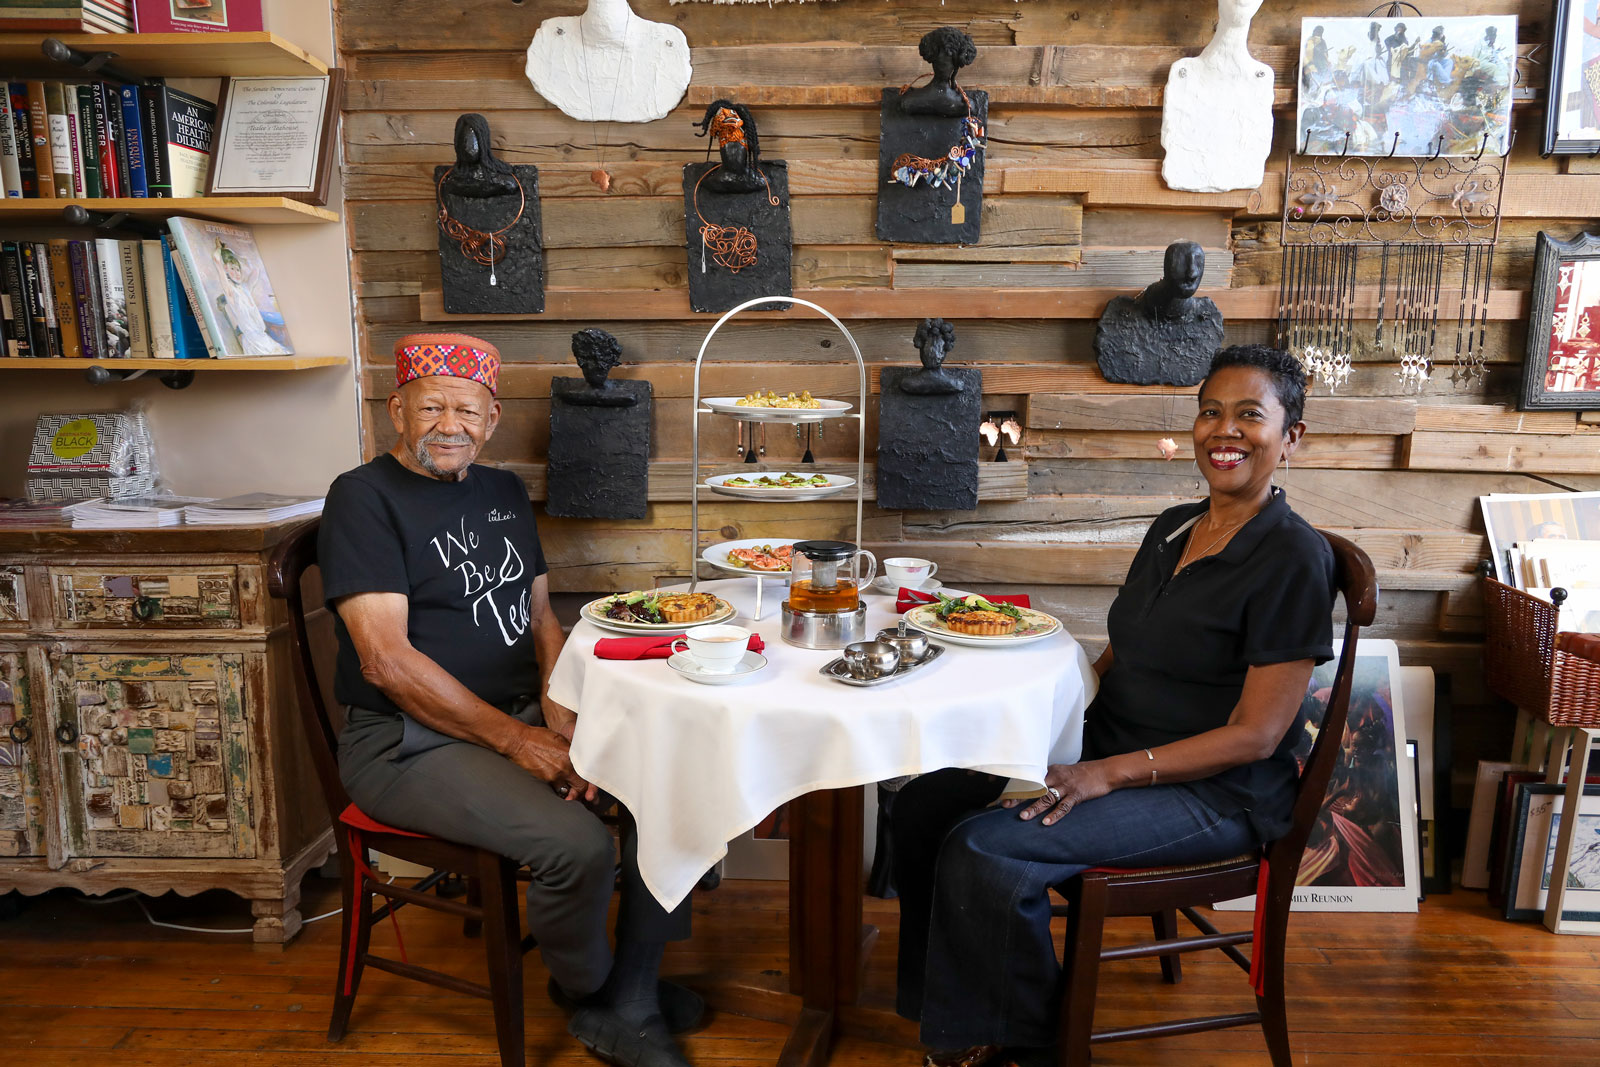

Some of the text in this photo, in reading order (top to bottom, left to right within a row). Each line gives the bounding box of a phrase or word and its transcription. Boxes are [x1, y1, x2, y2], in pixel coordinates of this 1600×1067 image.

[92, 84, 106, 147] RACE-BAITER
[149, 99, 155, 107] AN
[186, 106, 198, 117] AN
[1, 114, 14, 156] Studs Terkel
[171, 111, 213, 132] AMERICAN
[178, 124, 211, 142] HEALTH
[126, 129, 135, 169] TREATMENT
[131, 128, 141, 168] UNEQUAL
[176, 133, 209, 151] DILEMM
[123, 245, 132, 265] THE
[125, 267, 136, 300] MIND'S
[56, 436, 94, 447] BLACK
[430, 514, 480, 569] We
[453, 560, 496, 597] Be
[472, 580, 532, 647] Tea
[1311, 893, 1353, 903] REUNION
